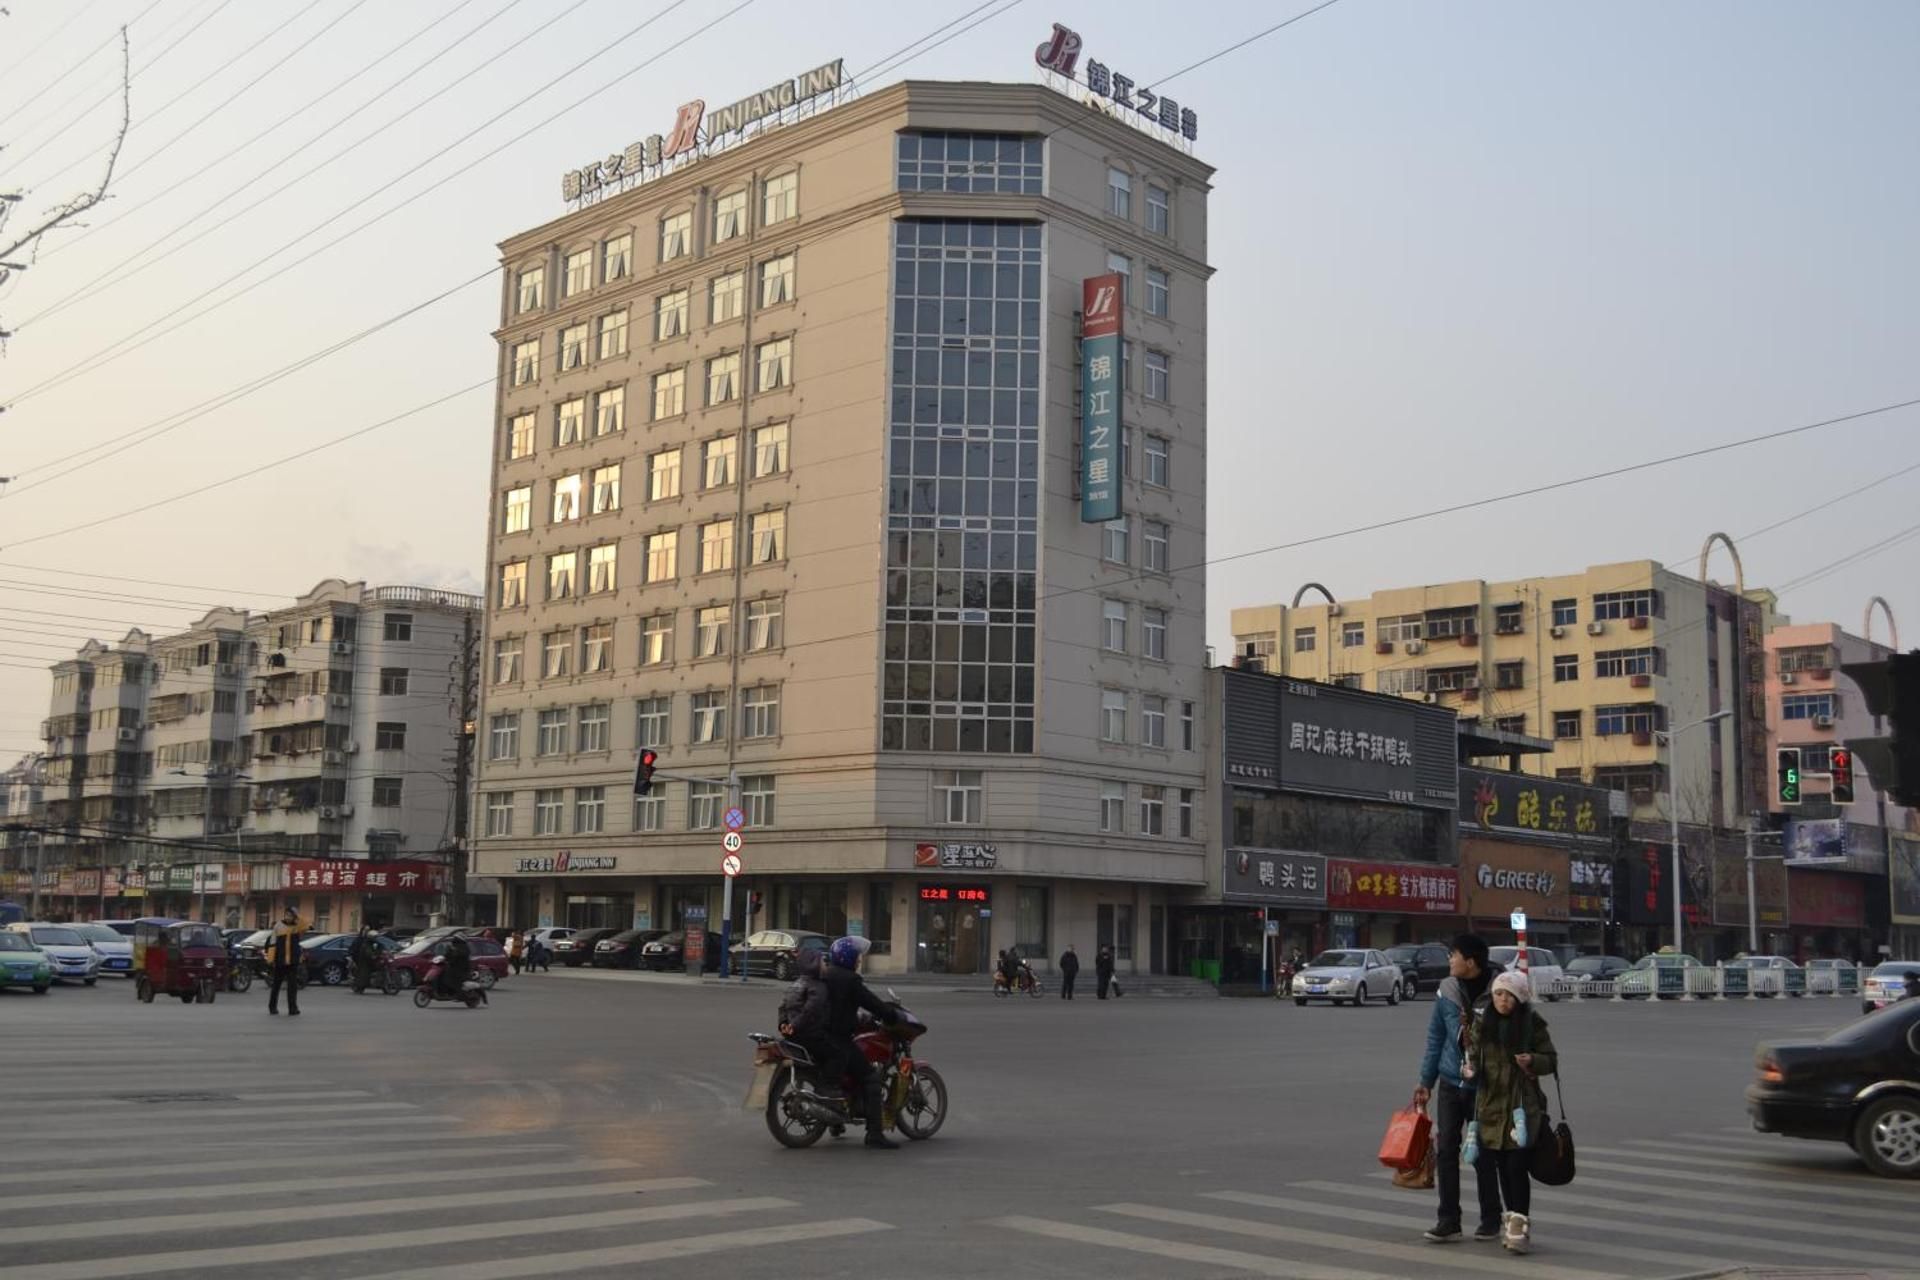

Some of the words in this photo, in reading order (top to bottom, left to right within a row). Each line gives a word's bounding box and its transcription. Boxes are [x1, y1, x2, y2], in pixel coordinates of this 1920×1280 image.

[706, 78, 796, 146] JINJIANG
[798, 57, 843, 101] INN
[1087, 57, 1180, 133] 锦江之星
[1088, 355, 1112, 485] 锦江之星
[1787, 769, 1796, 783] 6
[725, 836, 741, 848] 40
[1258, 861, 1318, 890] 鸭头记
